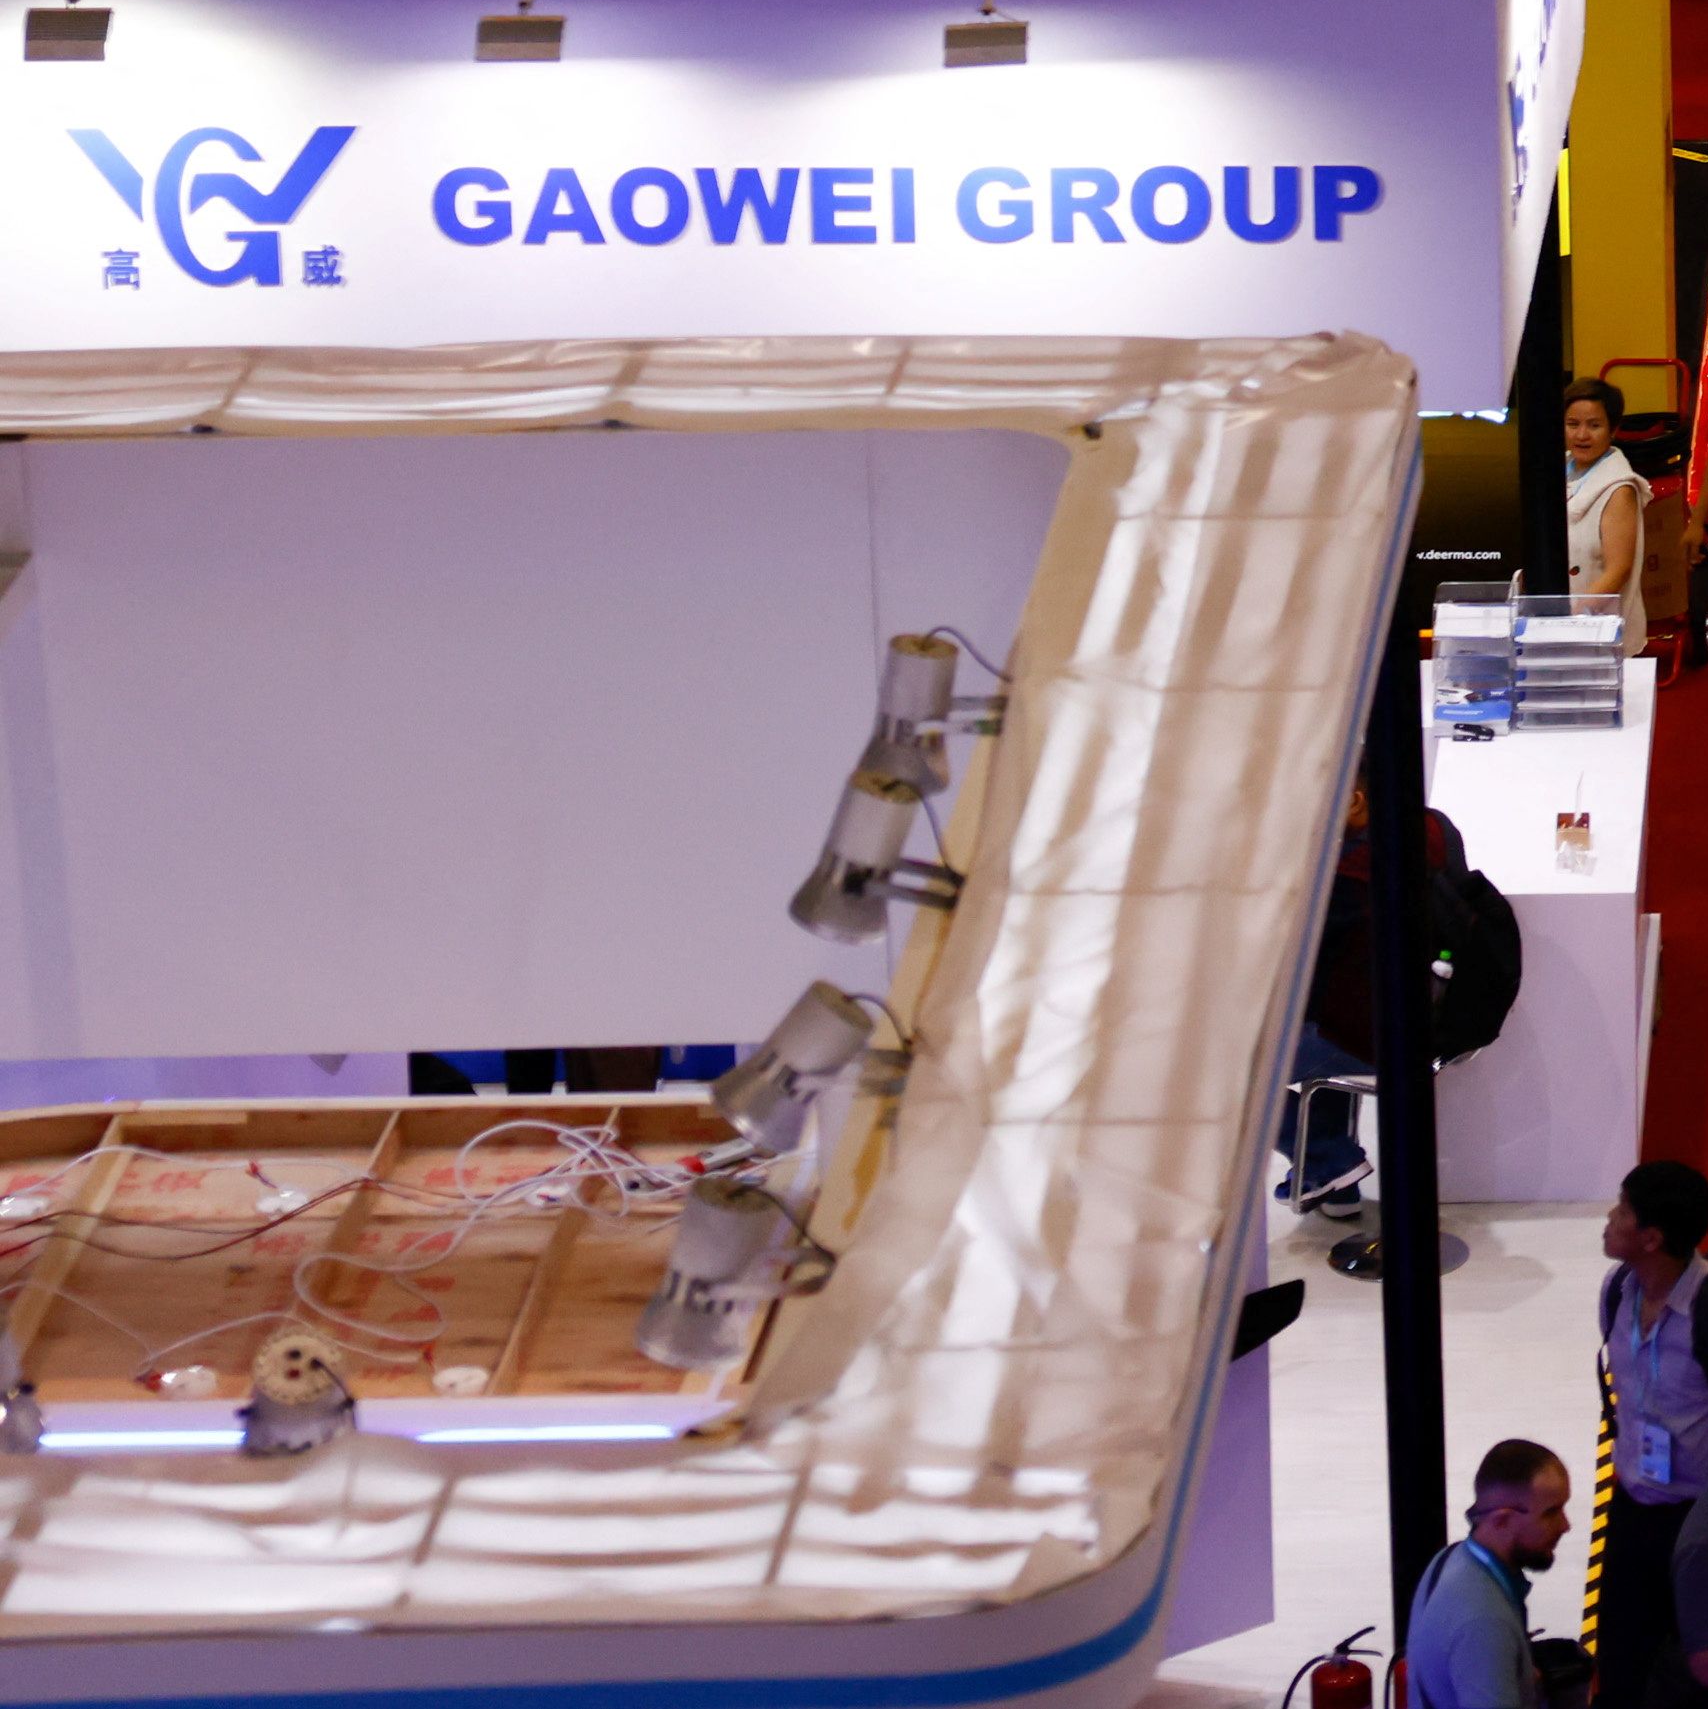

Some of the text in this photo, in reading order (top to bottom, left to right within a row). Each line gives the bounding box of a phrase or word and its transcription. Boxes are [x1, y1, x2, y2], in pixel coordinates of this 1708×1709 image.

[431, 164, 1384, 246] GAOWEI GROUP
[101, 244, 345, 290] 高 威
